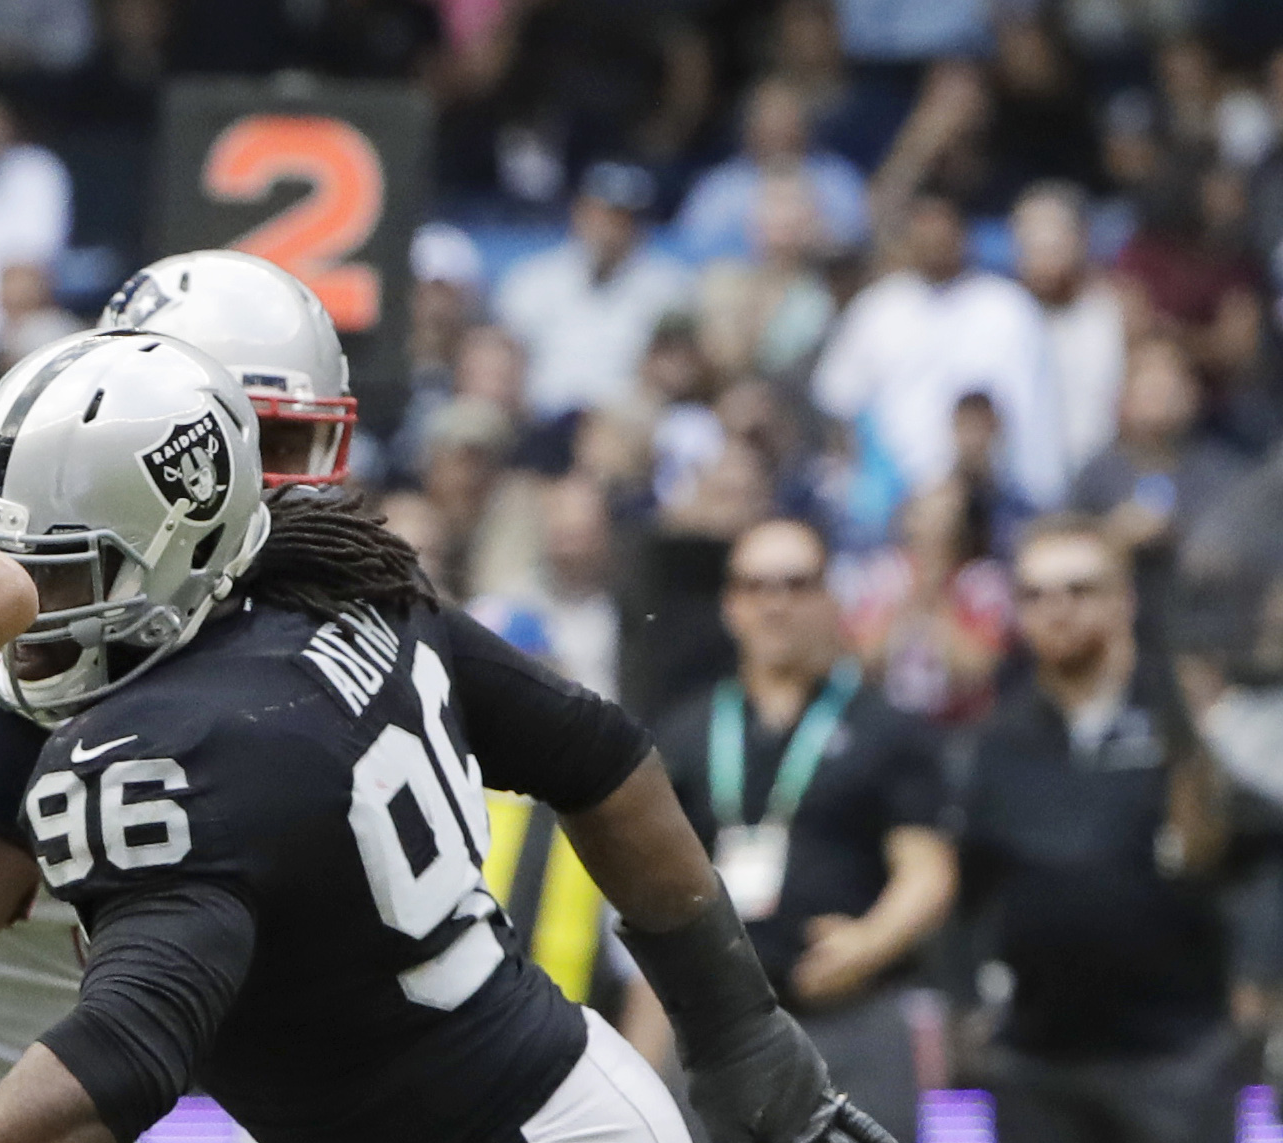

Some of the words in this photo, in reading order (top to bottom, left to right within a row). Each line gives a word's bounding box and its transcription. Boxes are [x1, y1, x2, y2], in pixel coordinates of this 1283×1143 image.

[200, 114, 386, 333] 2
[151, 417, 213, 465] RAIDERS
[26, 758, 193, 888] 96
